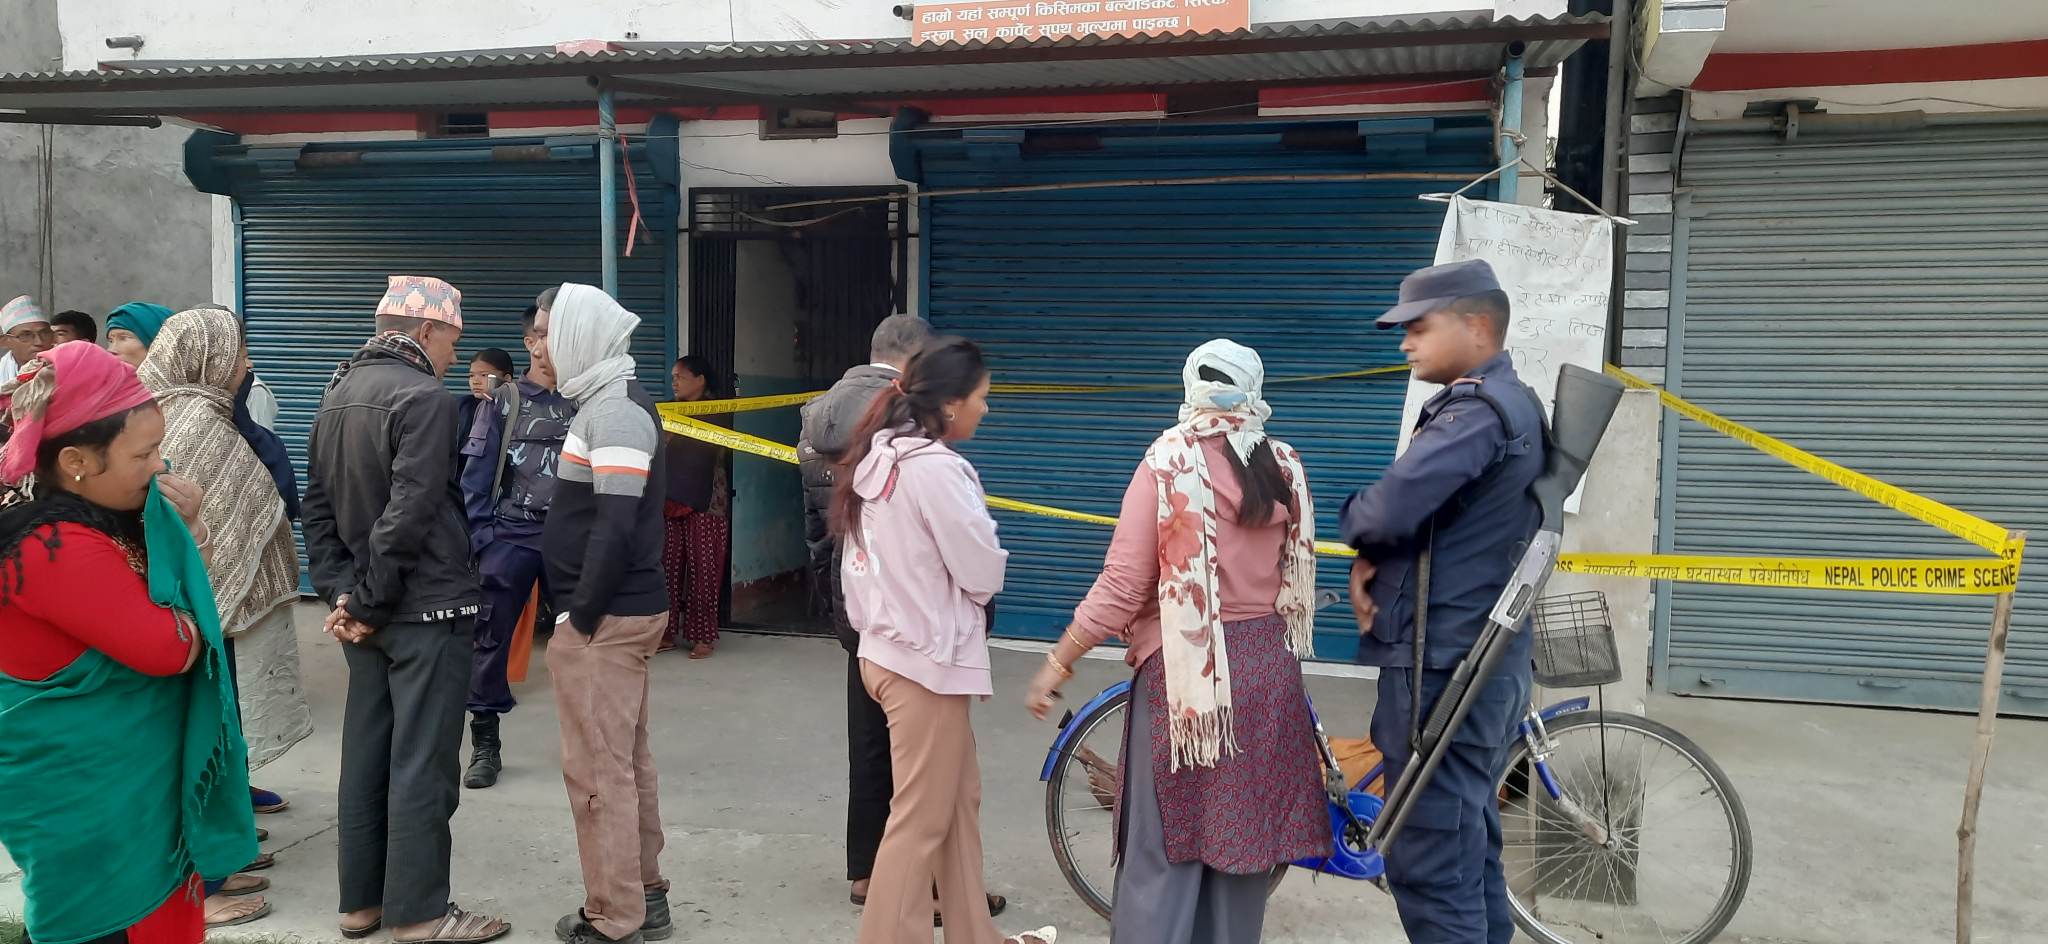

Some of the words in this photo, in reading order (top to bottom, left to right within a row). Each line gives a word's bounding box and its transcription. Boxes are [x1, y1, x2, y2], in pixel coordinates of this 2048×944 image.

[922, 8, 952, 24] हाम्रो
[1035, 2, 1100, 17] किसिमका
[1824, 566, 1864, 586] NEPAL
[1871, 567, 1918, 587] POLICE
[1925, 567, 1966, 588] CRIME
[1973, 564, 2016, 588] SCENE
